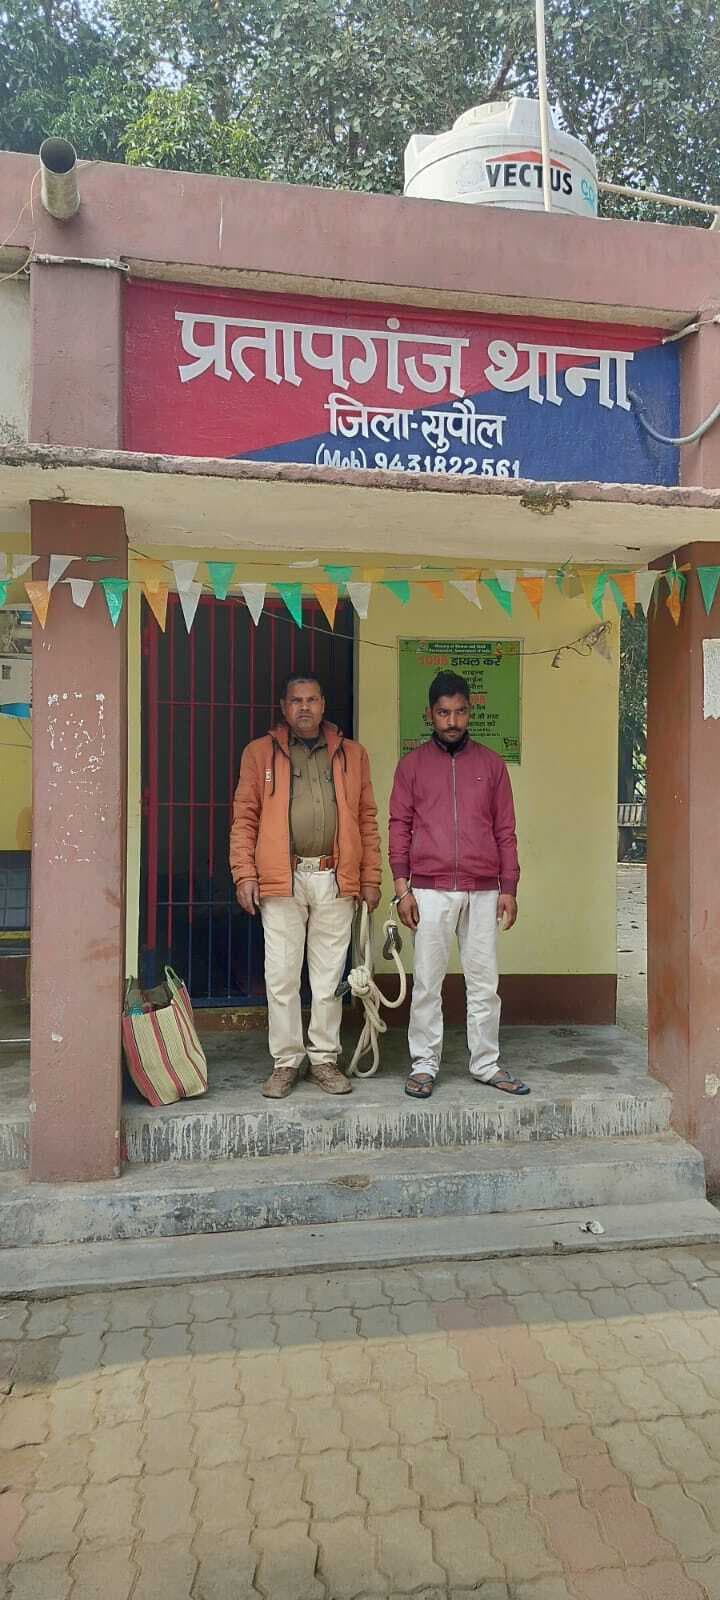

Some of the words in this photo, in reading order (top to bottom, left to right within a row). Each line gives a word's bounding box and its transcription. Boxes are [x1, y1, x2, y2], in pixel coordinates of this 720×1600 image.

[486, 163, 573, 196] VECTUS
[174, 311, 470, 397] प्रतापगंज
[485, 340, 634, 411] थाना
[374, 452, 520, 479] 9431822561
